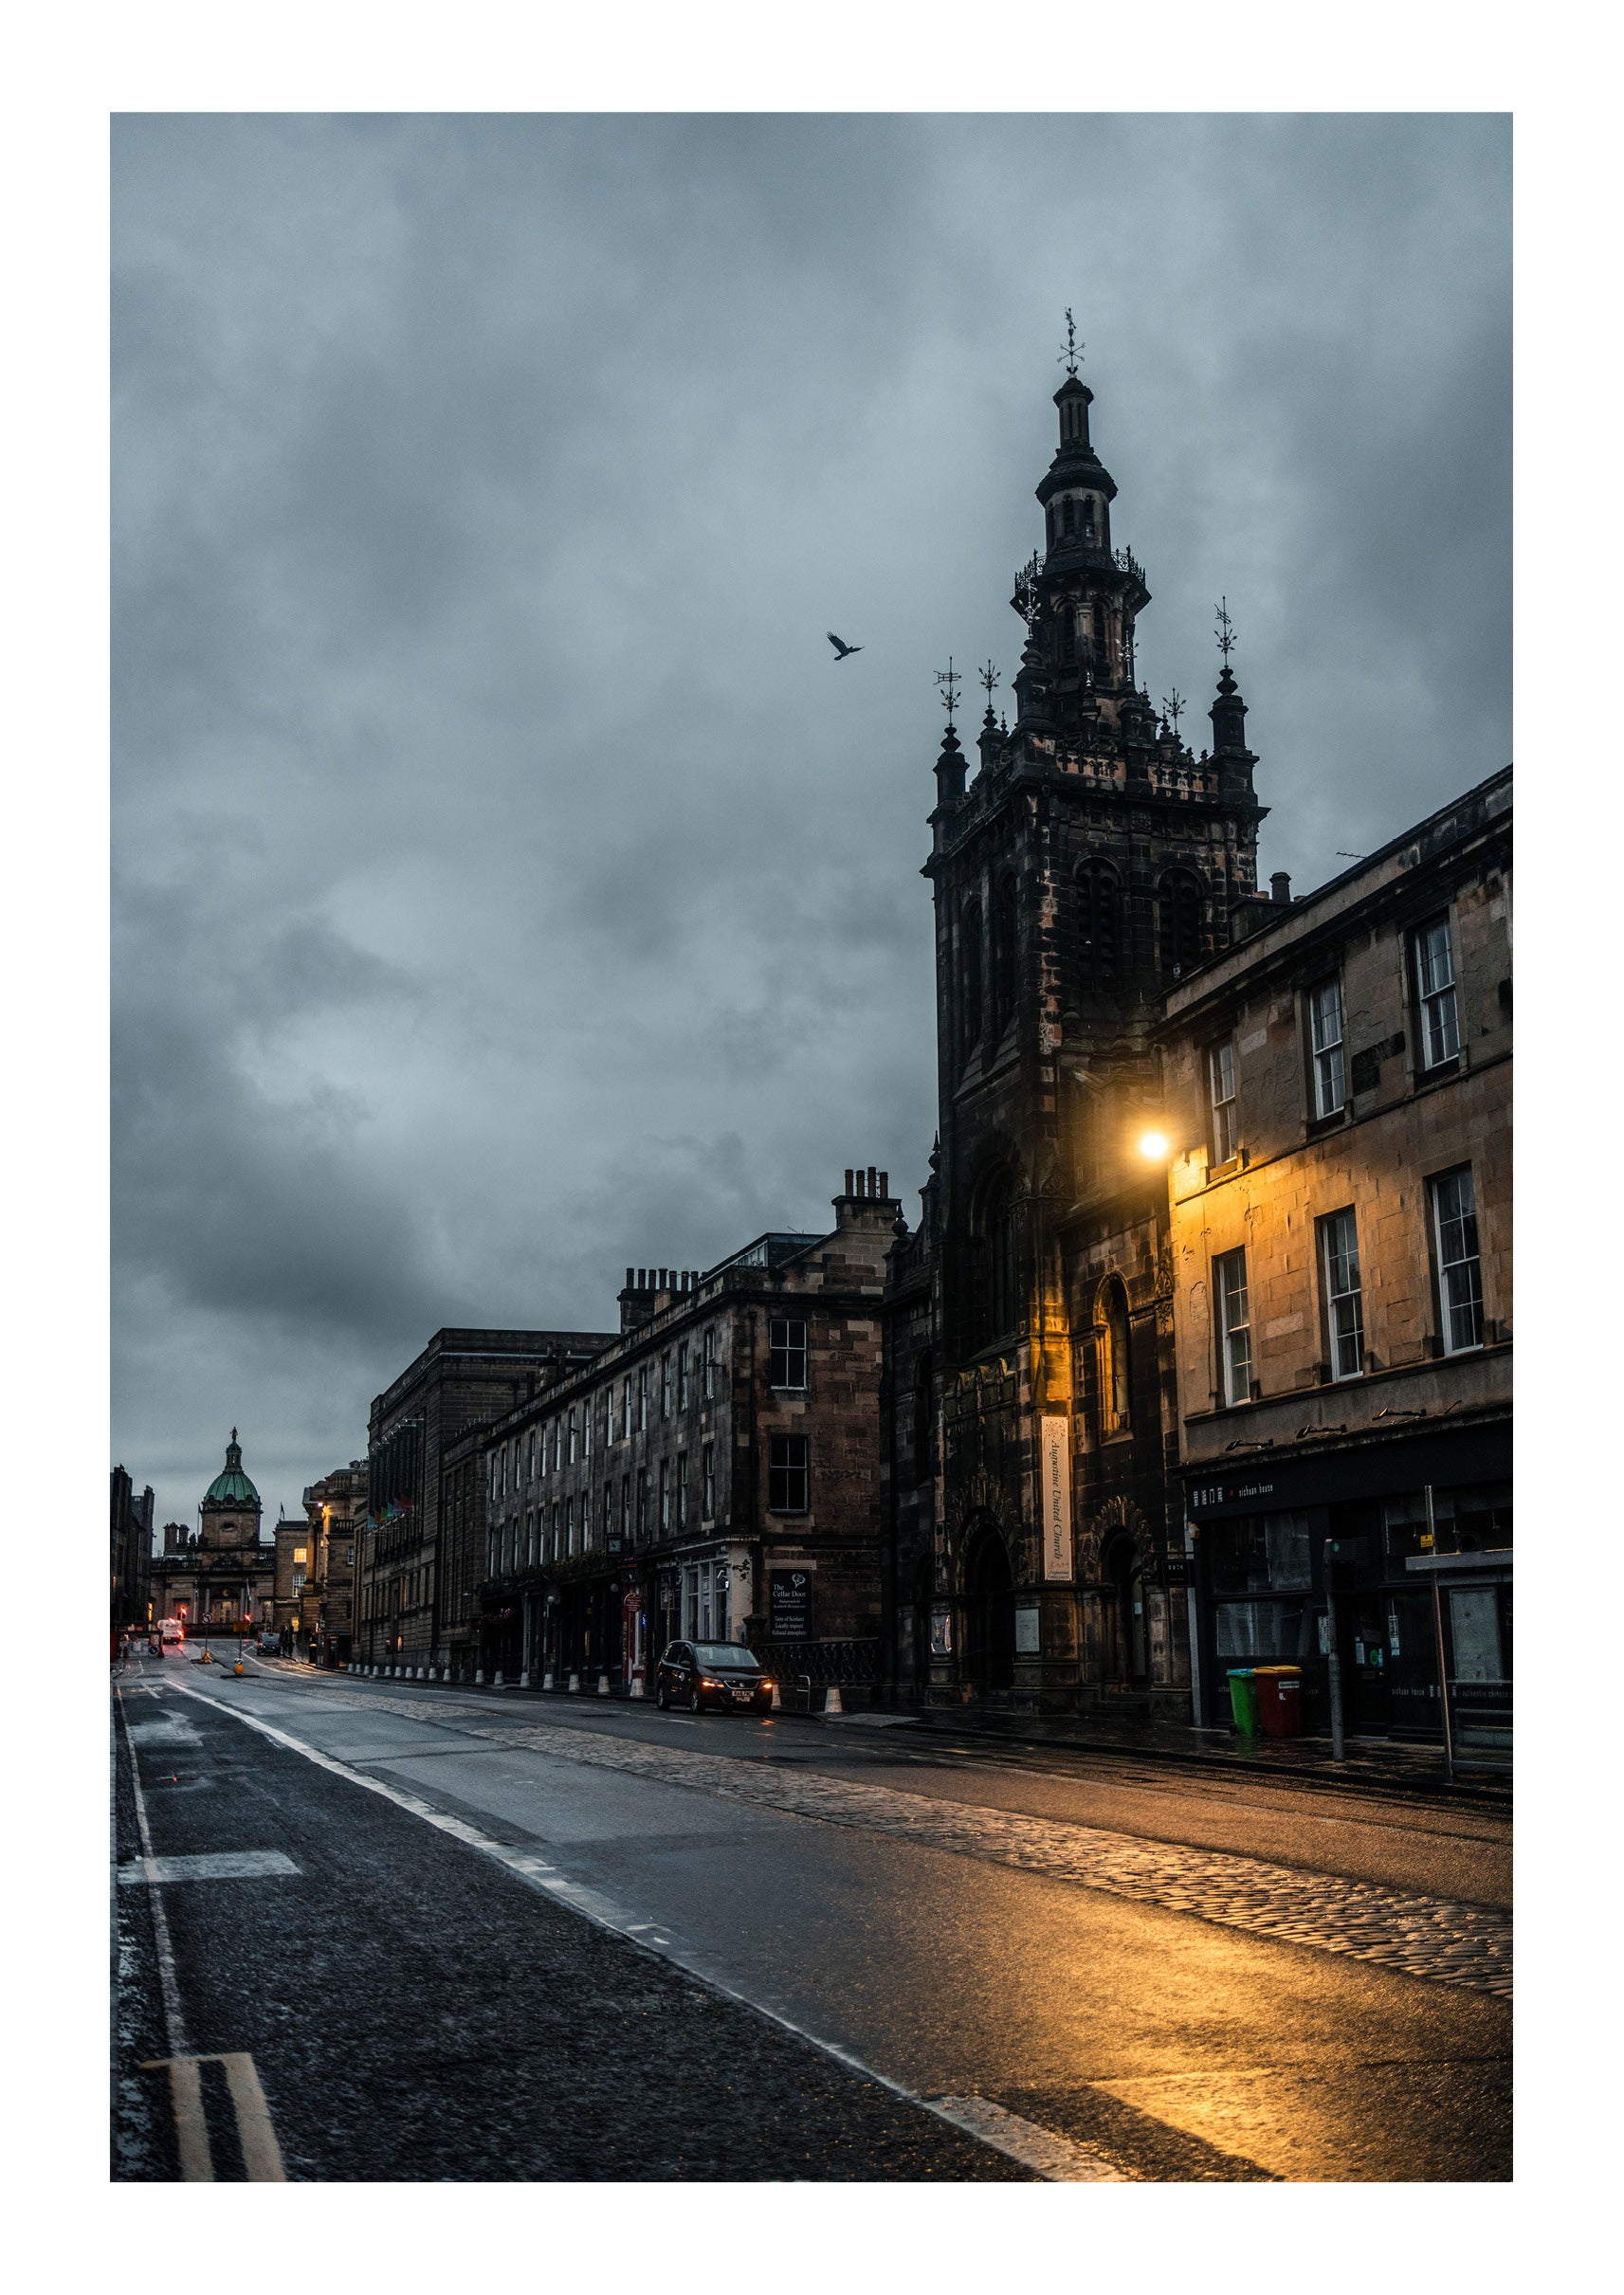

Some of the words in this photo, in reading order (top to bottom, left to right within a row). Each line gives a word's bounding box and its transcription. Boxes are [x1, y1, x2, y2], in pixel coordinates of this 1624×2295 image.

[1049, 1440, 1060, 1486] Augustine
[1258, 1482, 1273, 1494] house
[1052, 1490, 1062, 1521] United
[1053, 1523, 1063, 1559] Church
